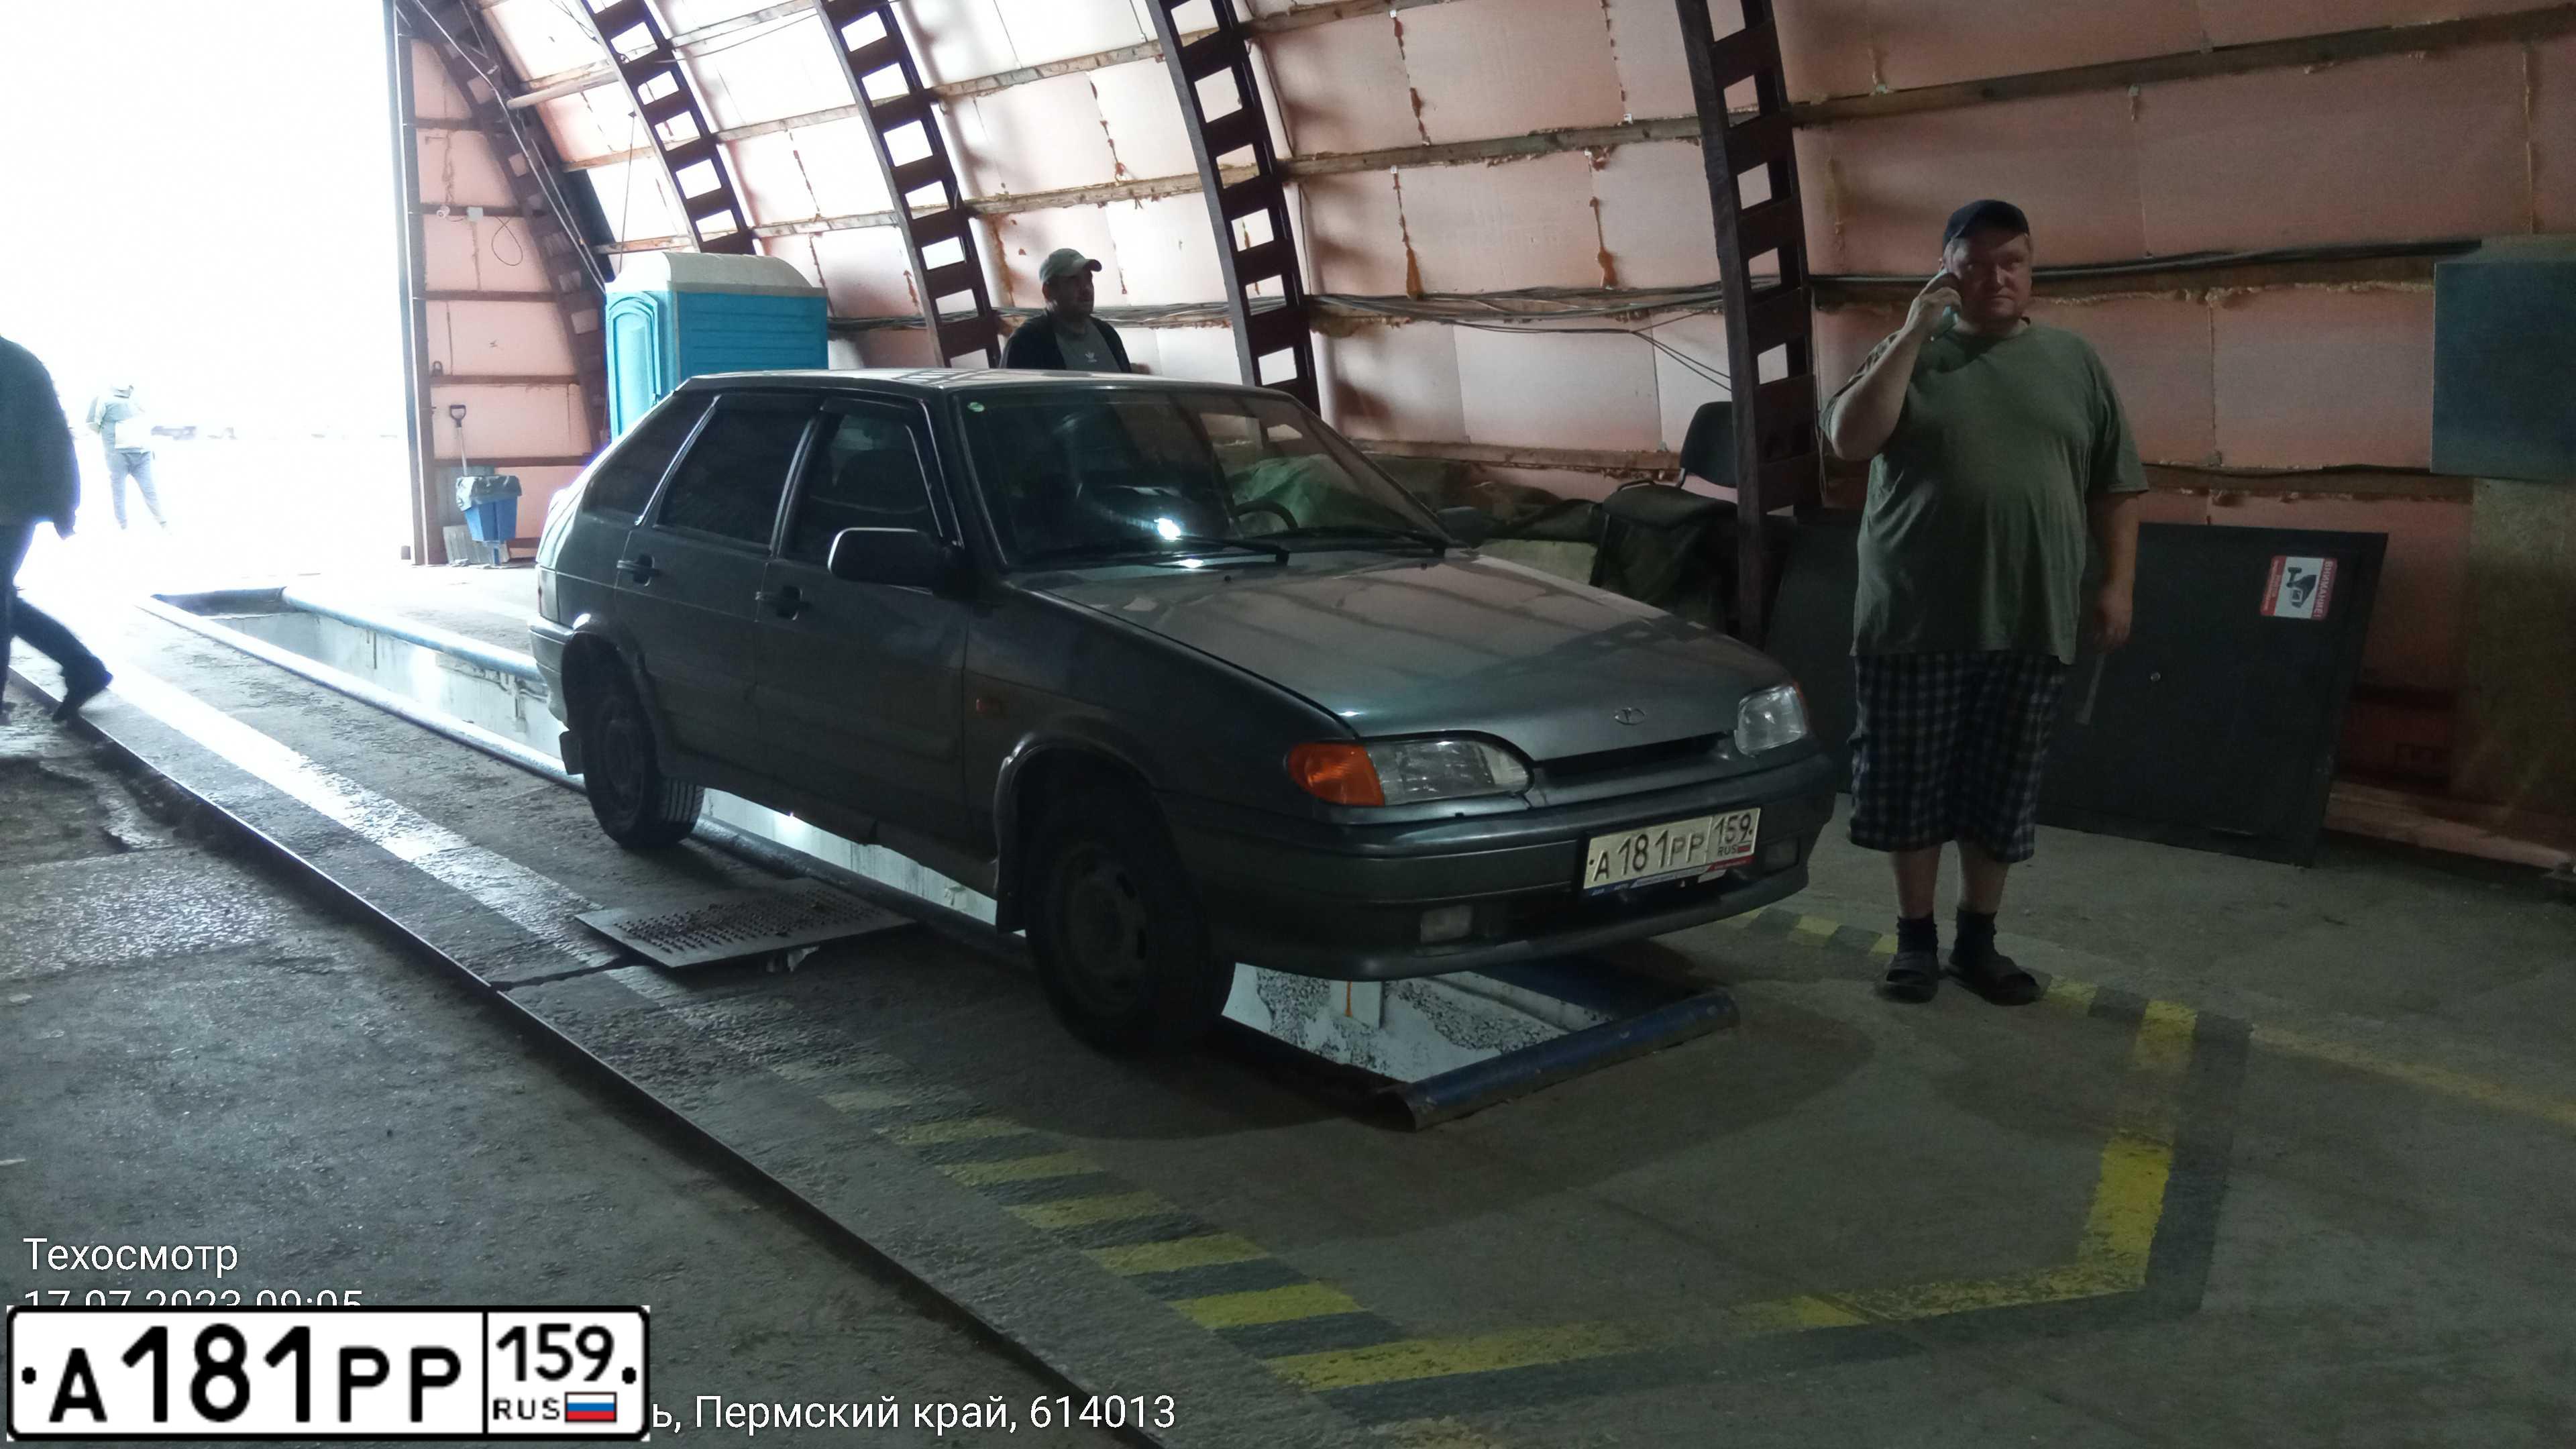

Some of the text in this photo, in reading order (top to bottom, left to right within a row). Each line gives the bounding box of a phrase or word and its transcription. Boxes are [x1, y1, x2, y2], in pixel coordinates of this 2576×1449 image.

[2313, 560, 2333, 617] ВНИМАНИЕ!
[1712, 814, 1751, 845] 159
[1717, 846, 1737, 857] RUS
